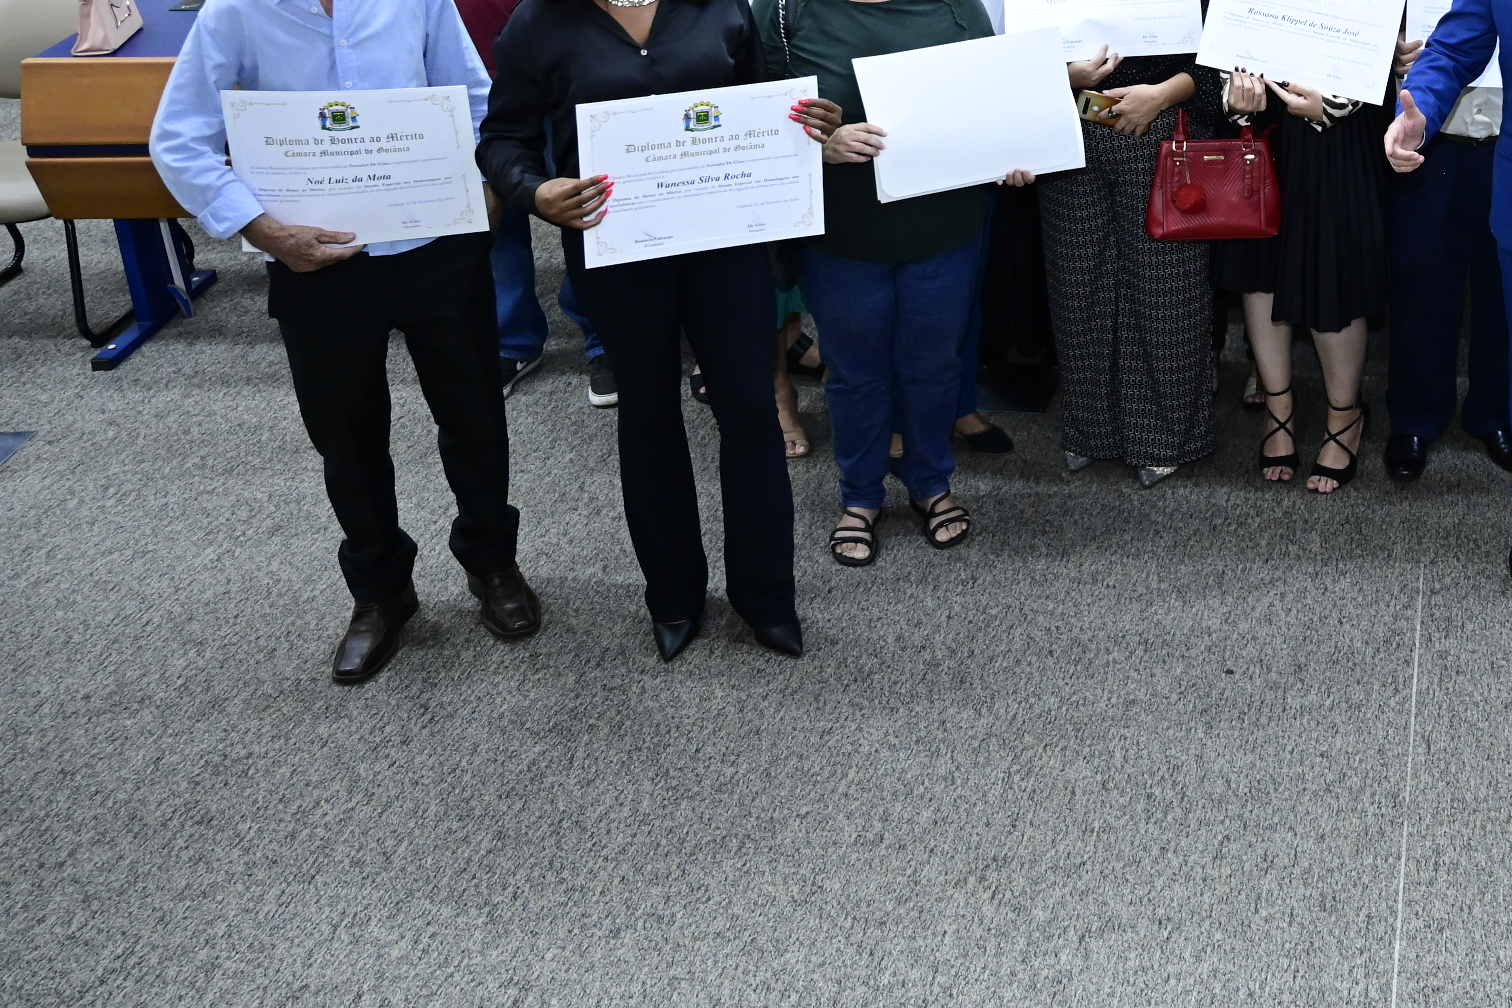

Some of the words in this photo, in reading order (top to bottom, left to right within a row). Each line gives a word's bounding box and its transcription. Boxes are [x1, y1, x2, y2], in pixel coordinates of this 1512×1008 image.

[264, 136, 310, 147] Diploma
[314, 135, 324, 145] de
[624, 141, 671, 154] Diploma
[675, 138, 686, 148] de
[729, 133, 740, 141] ao
[328, 176, 349, 184] Luiz
[352, 175, 363, 183] da
[366, 174, 391, 182] Mota
[698, 173, 720, 185] Silva
[724, 171, 752, 180] Rocha
